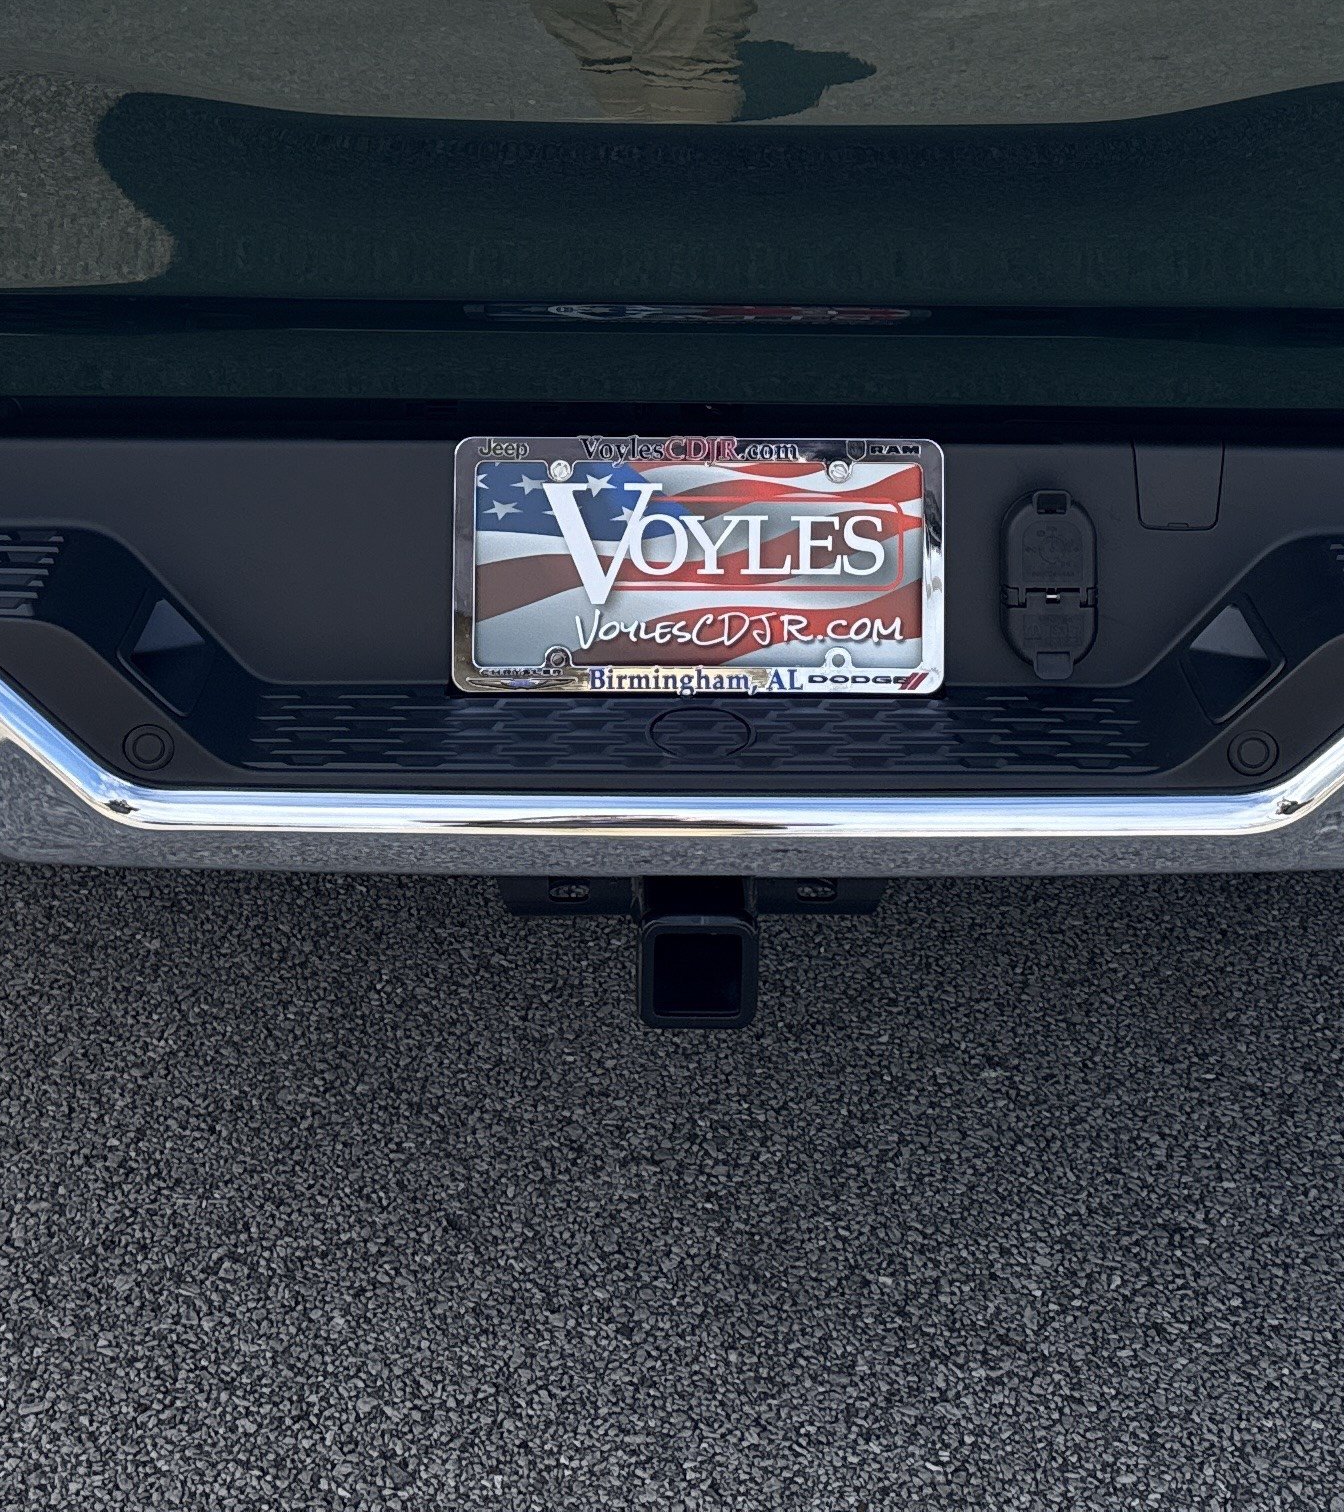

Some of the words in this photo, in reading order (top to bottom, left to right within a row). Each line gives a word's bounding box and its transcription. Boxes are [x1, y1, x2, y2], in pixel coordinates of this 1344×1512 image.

[478, 439, 530, 460] Jeep
[576, 435, 800, 467] VoylesCDJR.com
[869, 445, 922, 456] RAM
[588, 666, 759, 695] Birmingham,
[766, 668, 804, 691] AL
[807, 674, 908, 685] DODGE
